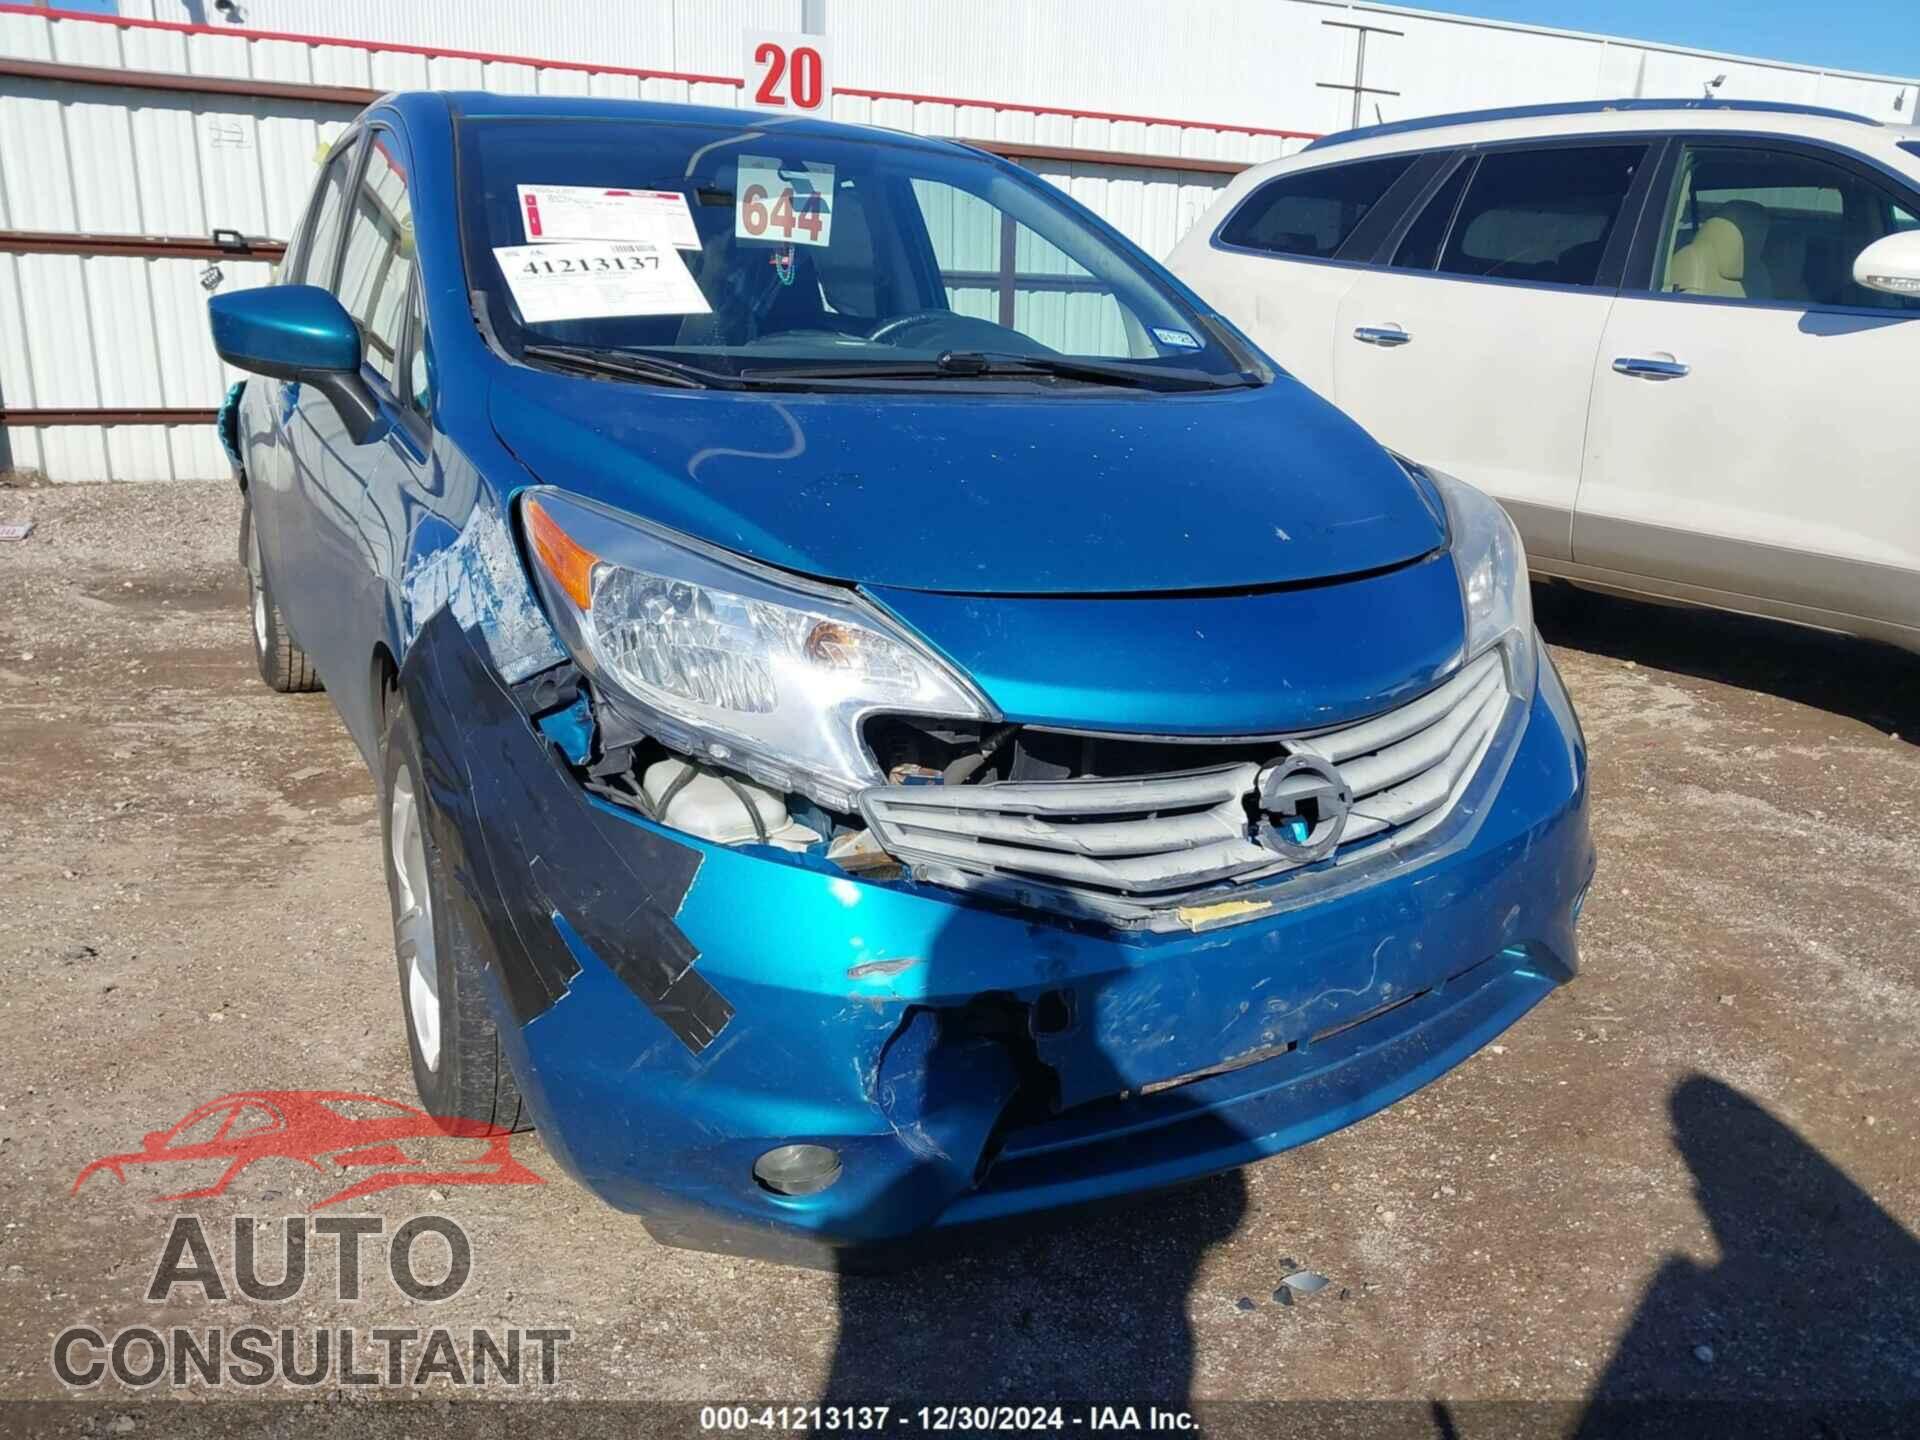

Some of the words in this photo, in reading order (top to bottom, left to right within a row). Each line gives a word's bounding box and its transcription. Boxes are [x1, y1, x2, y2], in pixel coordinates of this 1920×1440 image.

[754, 43, 823, 110] 20
[742, 184, 823, 241] 644
[523, 256, 660, 275] 41213137
